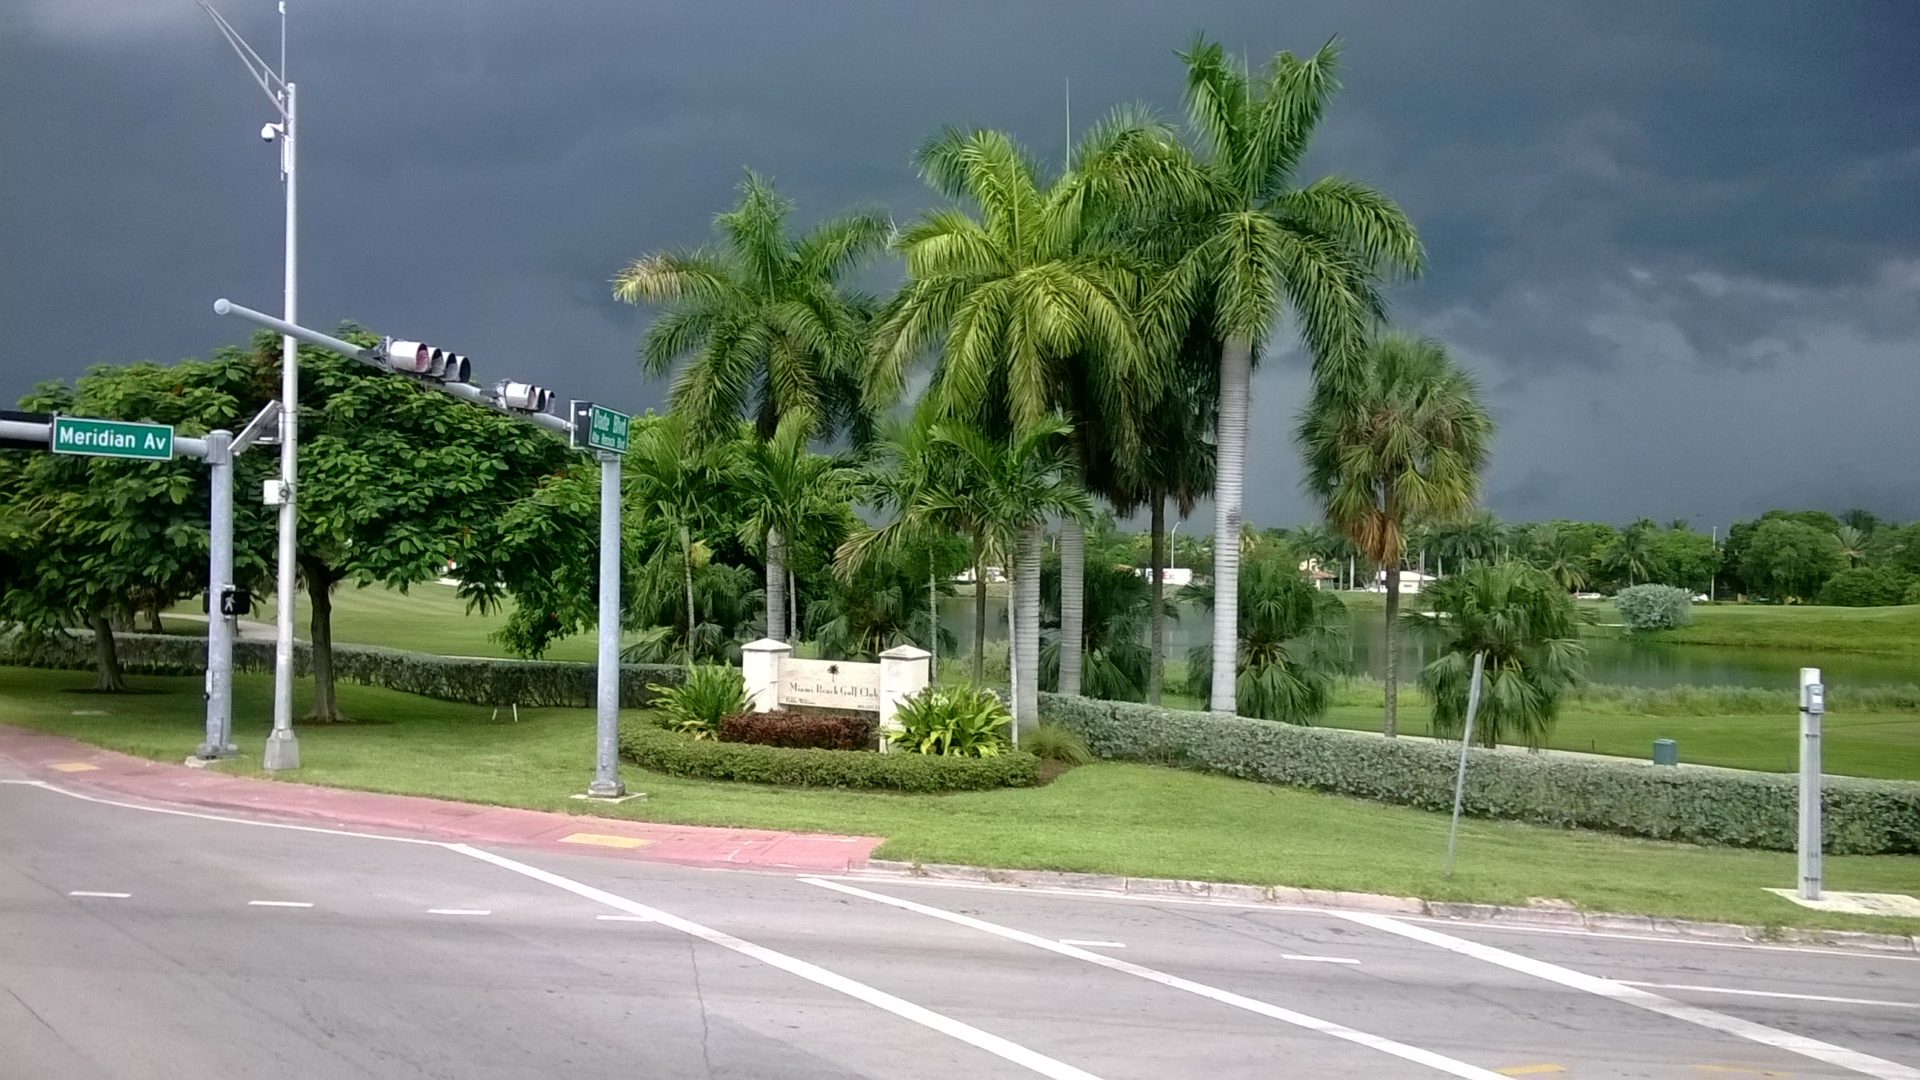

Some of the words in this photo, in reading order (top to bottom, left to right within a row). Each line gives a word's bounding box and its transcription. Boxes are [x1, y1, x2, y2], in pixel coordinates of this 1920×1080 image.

[59, 426, 136, 448] Meridian
[143, 432, 166, 450] Av
[789, 681, 814, 693] Miami
[816, 683, 838, 695] Beach
[840, 686, 857, 698] Golf
[859, 687, 879, 698] Club
